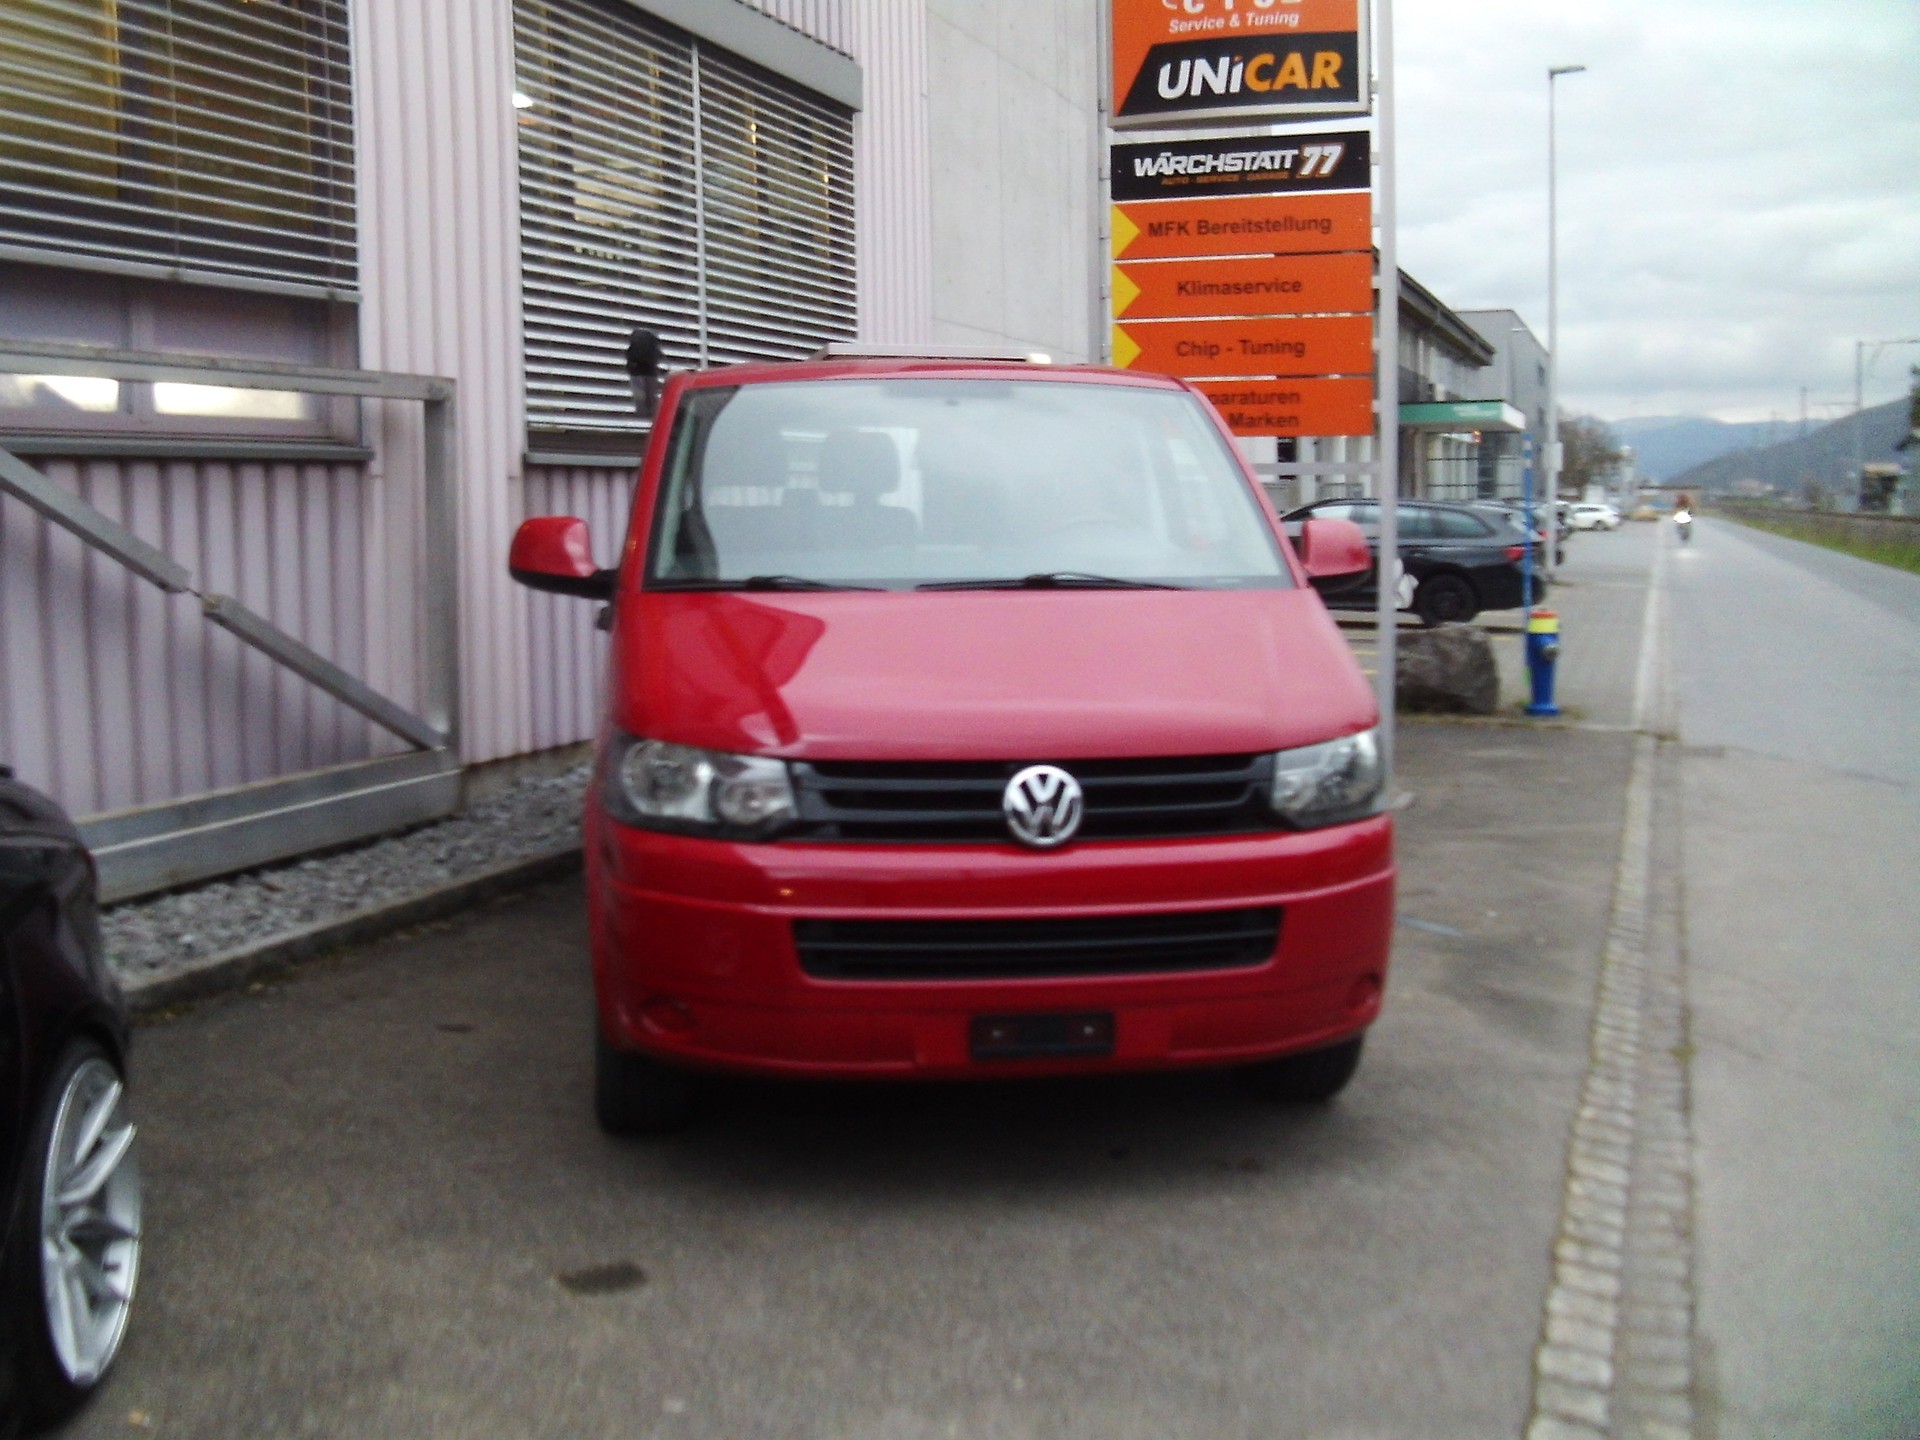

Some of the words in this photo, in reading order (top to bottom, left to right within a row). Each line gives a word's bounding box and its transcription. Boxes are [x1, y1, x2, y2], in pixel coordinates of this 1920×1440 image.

[1169, 17, 1225, 33] Service
[1229, 13, 1240, 28] &
[1246, 11, 1300, 27] Tuning
[1297, 143, 1344, 178] 77
[1149, 221, 1190, 237] MFK
[1197, 215, 1332, 236] Bereitstellung
[1177, 279, 1303, 297] Klimaservice
[1176, 340, 1220, 358] Chip
[1240, 339, 1306, 357] Tuning
[1206, 390, 1300, 405] paraturen
[1229, 412, 1298, 428] Marken
